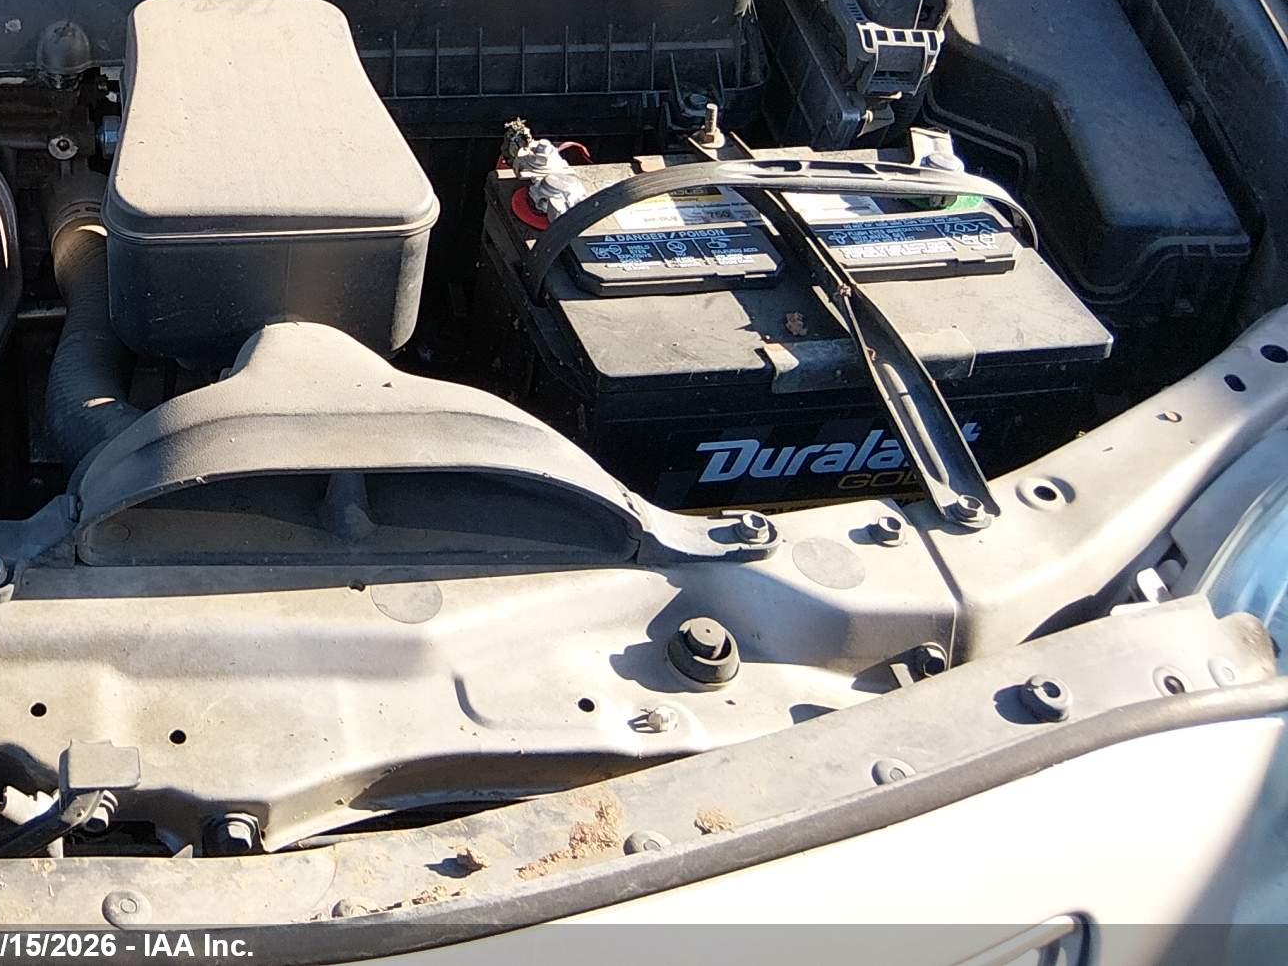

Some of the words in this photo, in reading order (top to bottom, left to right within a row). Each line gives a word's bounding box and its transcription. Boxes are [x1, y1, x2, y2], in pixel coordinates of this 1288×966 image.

[616, 232, 667, 242] DANGER
[678, 228, 725, 238] POISON
[695, 422, 981, 483] Durala
[837, 470, 919, 490] GOL
